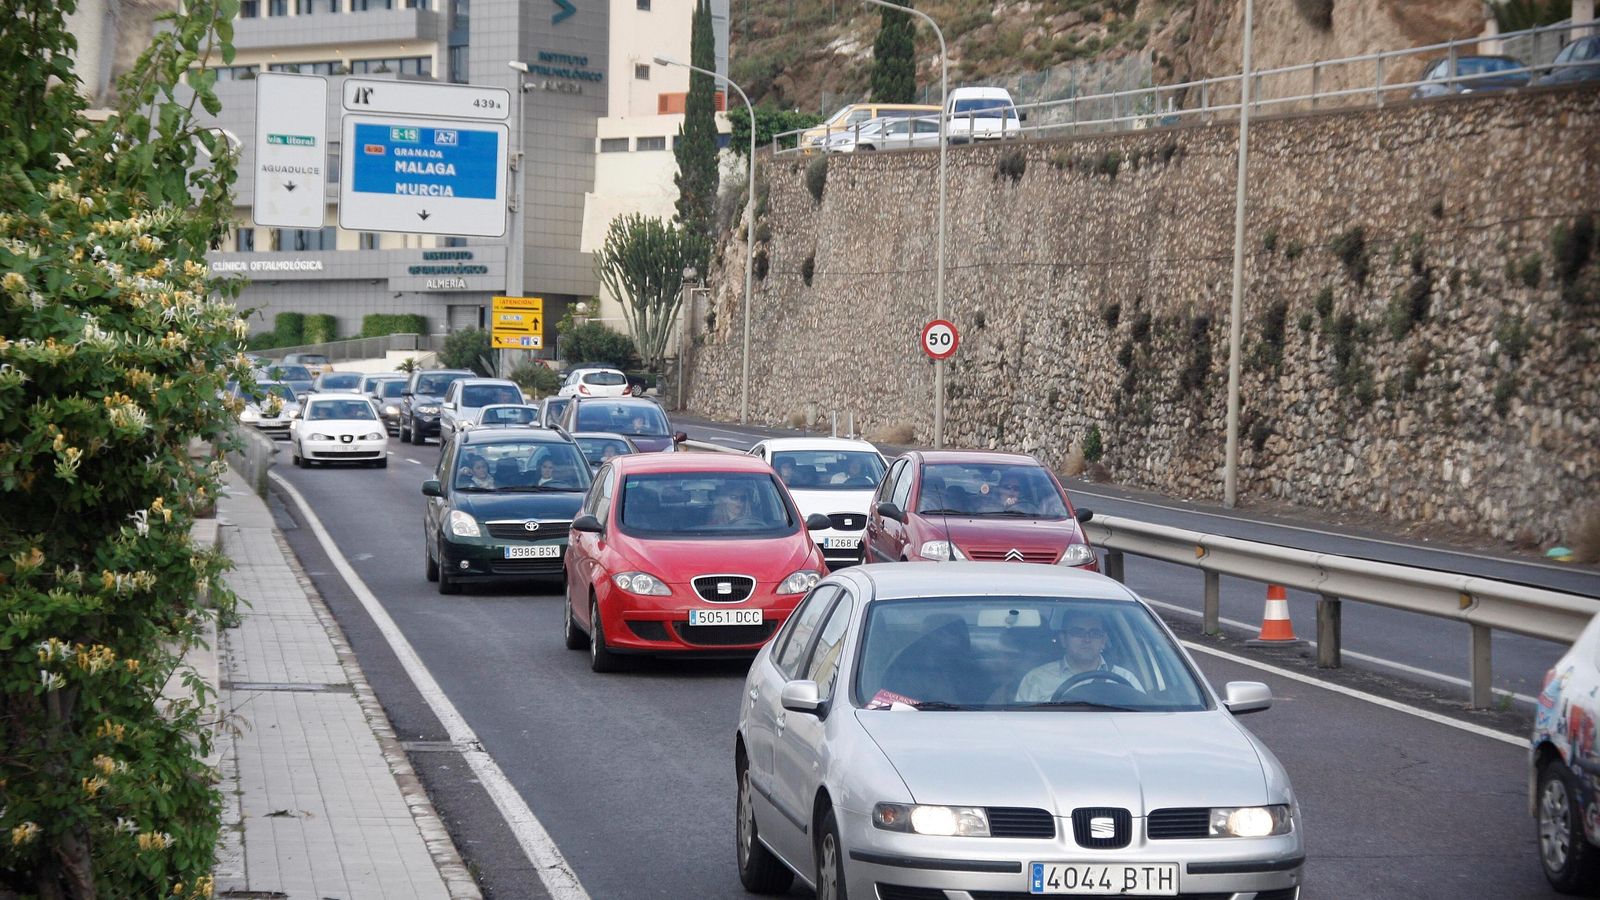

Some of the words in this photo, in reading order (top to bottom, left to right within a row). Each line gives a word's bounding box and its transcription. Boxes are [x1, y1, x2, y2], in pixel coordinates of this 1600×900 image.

[286, 135, 314, 146] litoral
[391, 128, 416, 140] E-15
[436, 131, 455, 143] A-7
[393, 147, 443, 159] GRANADA
[262, 164, 320, 175] AGUADULCE
[395, 160, 456, 176] MALAGA
[395, 182, 454, 198] MURCIA
[929, 332, 951, 346] 50
[830, 538, 852, 548] 1268
[511, 547, 536, 557] 9986
[538, 547, 557, 556] BSK
[699, 611, 730, 624] 5051
[735, 611, 760, 624] DCC
[1047, 866, 1113, 890] 4044
[1122, 866, 1173, 891] BTH
